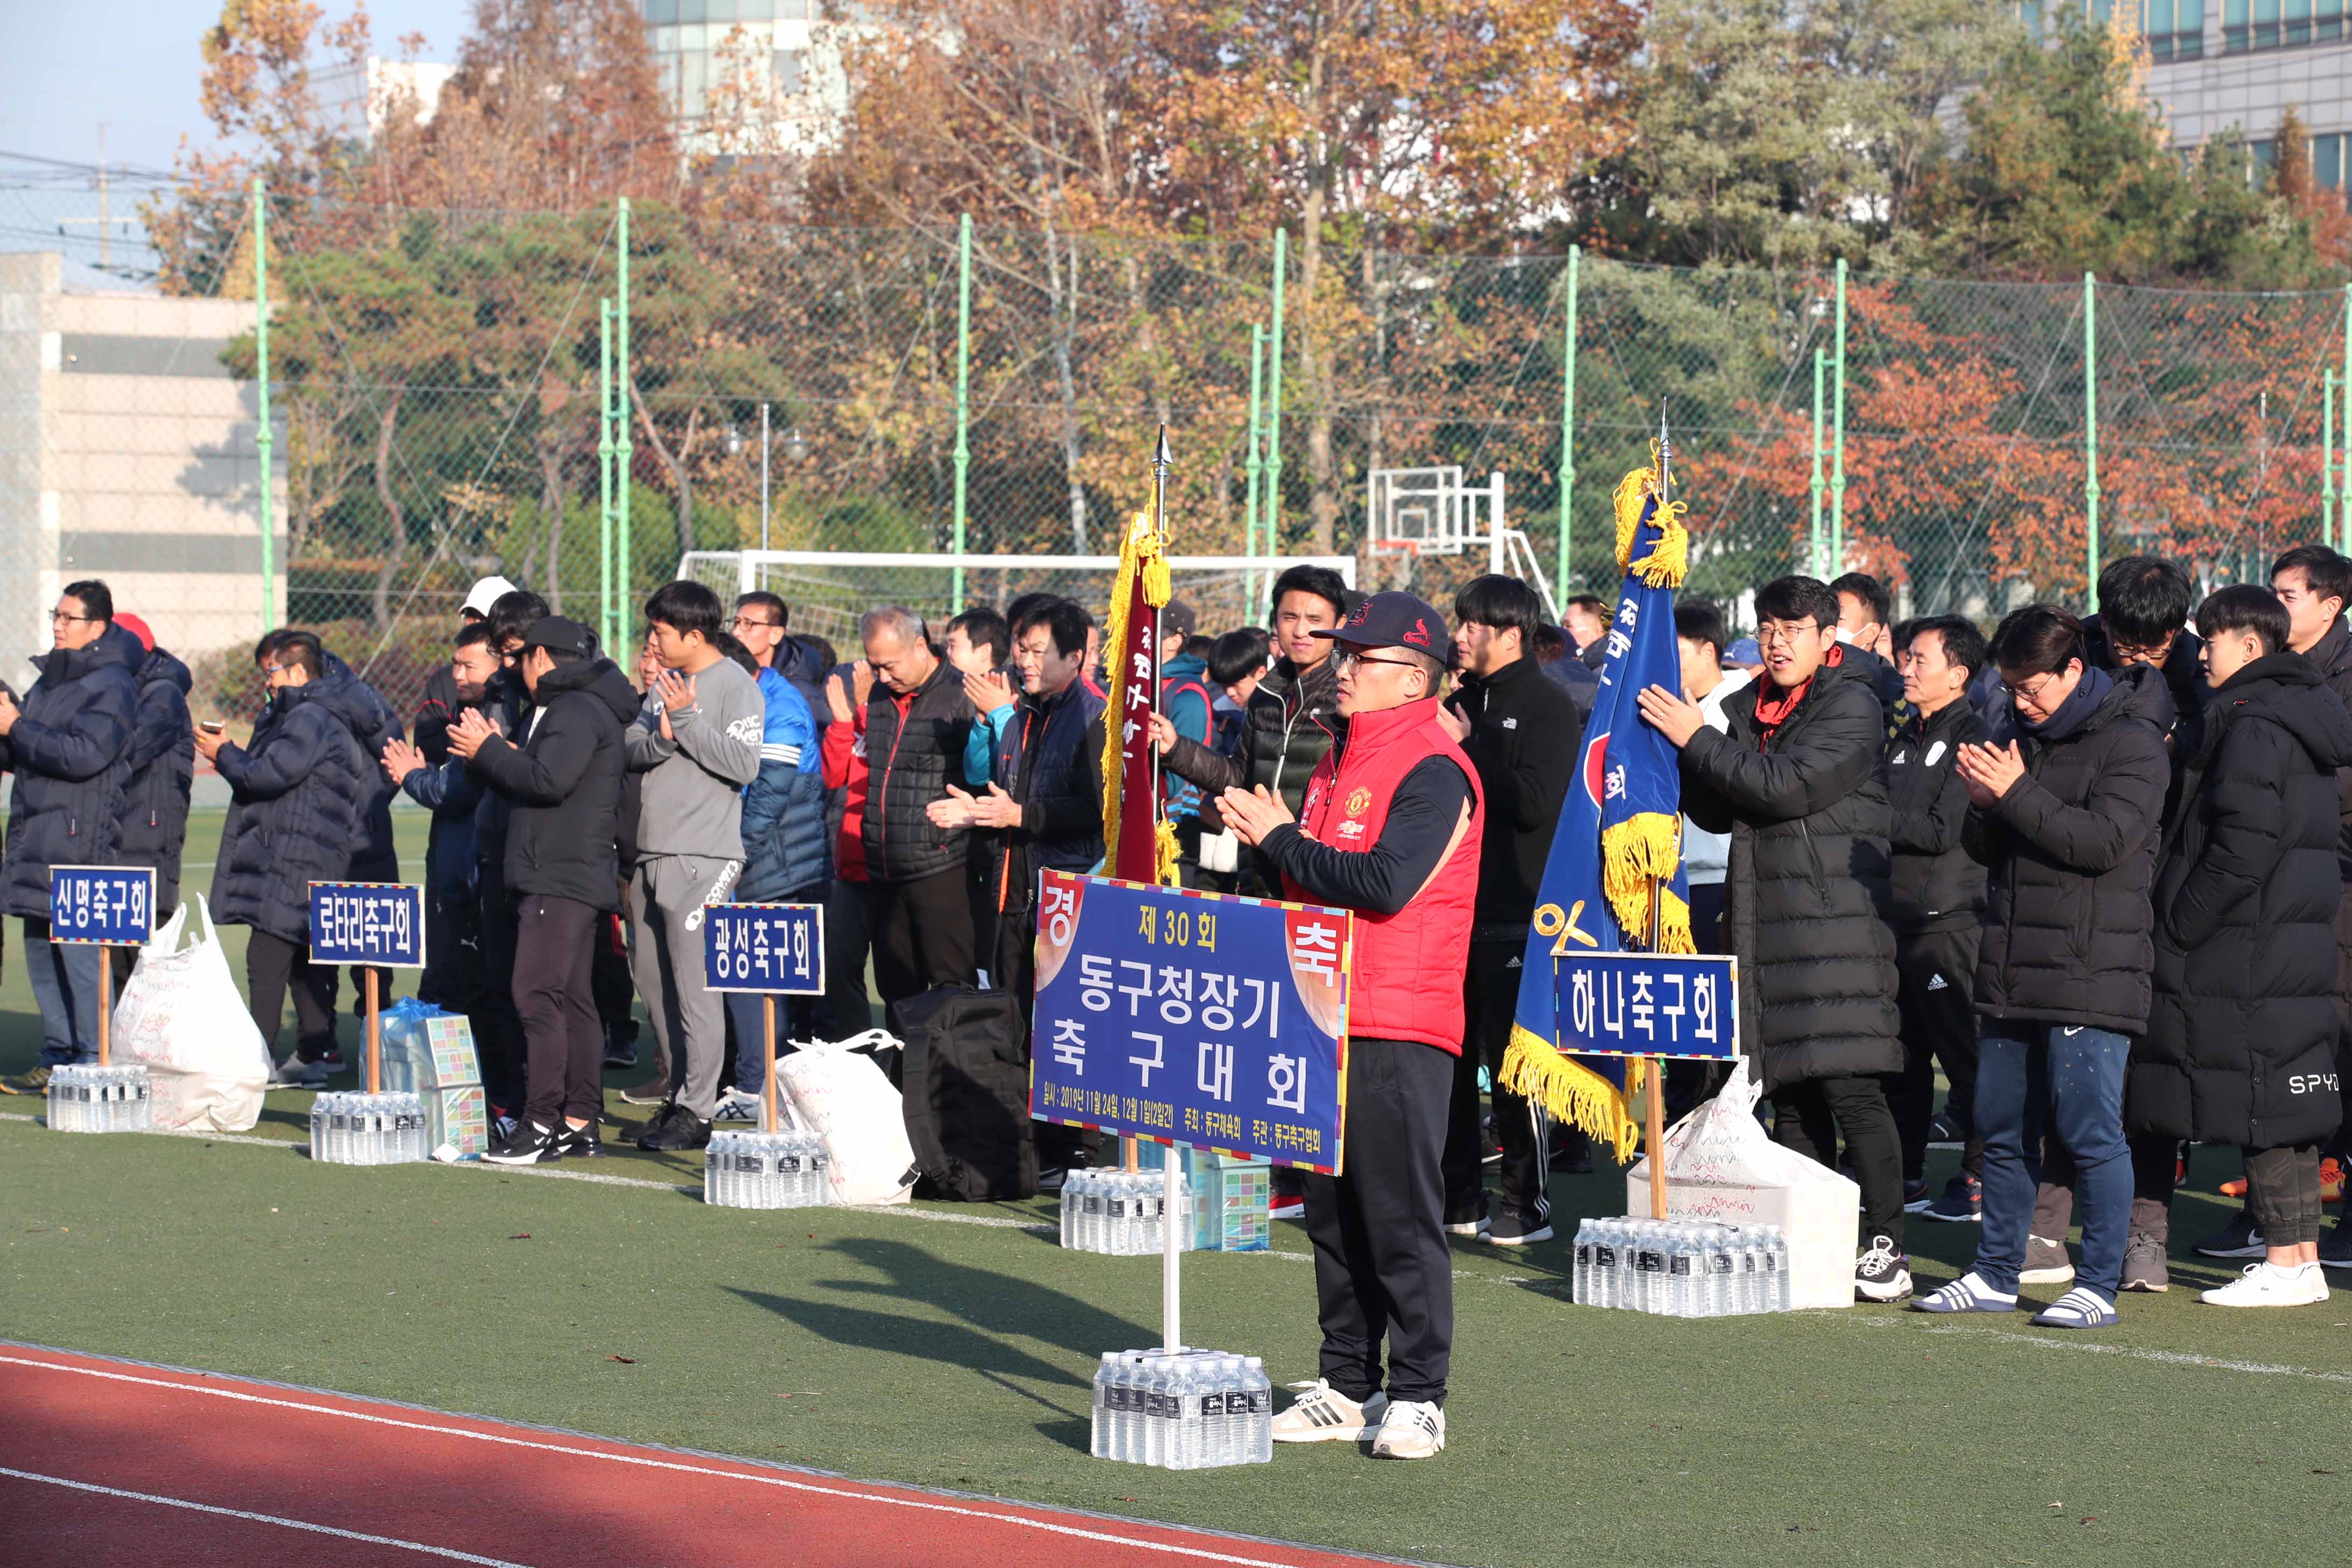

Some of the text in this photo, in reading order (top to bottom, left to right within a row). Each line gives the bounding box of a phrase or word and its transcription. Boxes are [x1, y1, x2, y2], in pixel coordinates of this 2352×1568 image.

[57, 878, 146, 929] 신명축구회
[320, 896, 411, 954] 로타리축구회
[1044, 886, 1074, 947] 경
[1138, 905, 1217, 953] 제 30 회
[715, 918, 810, 980] 광성축구회
[1293, 922, 1338, 988] 축
[1079, 954, 1280, 1039] 동구청장기
[1572, 969, 1717, 1044] 하나축구회
[1928, 982, 1948, 990] adidas
[1061, 1086, 1084, 1112] 2019년
[1086, 1090, 1101, 1116] 11월
[1122, 1097, 1138, 1122] 12월
[1205, 1111, 1241, 1142] 동구체육회
[1275, 1123, 1321, 1155] 동구축구협회
